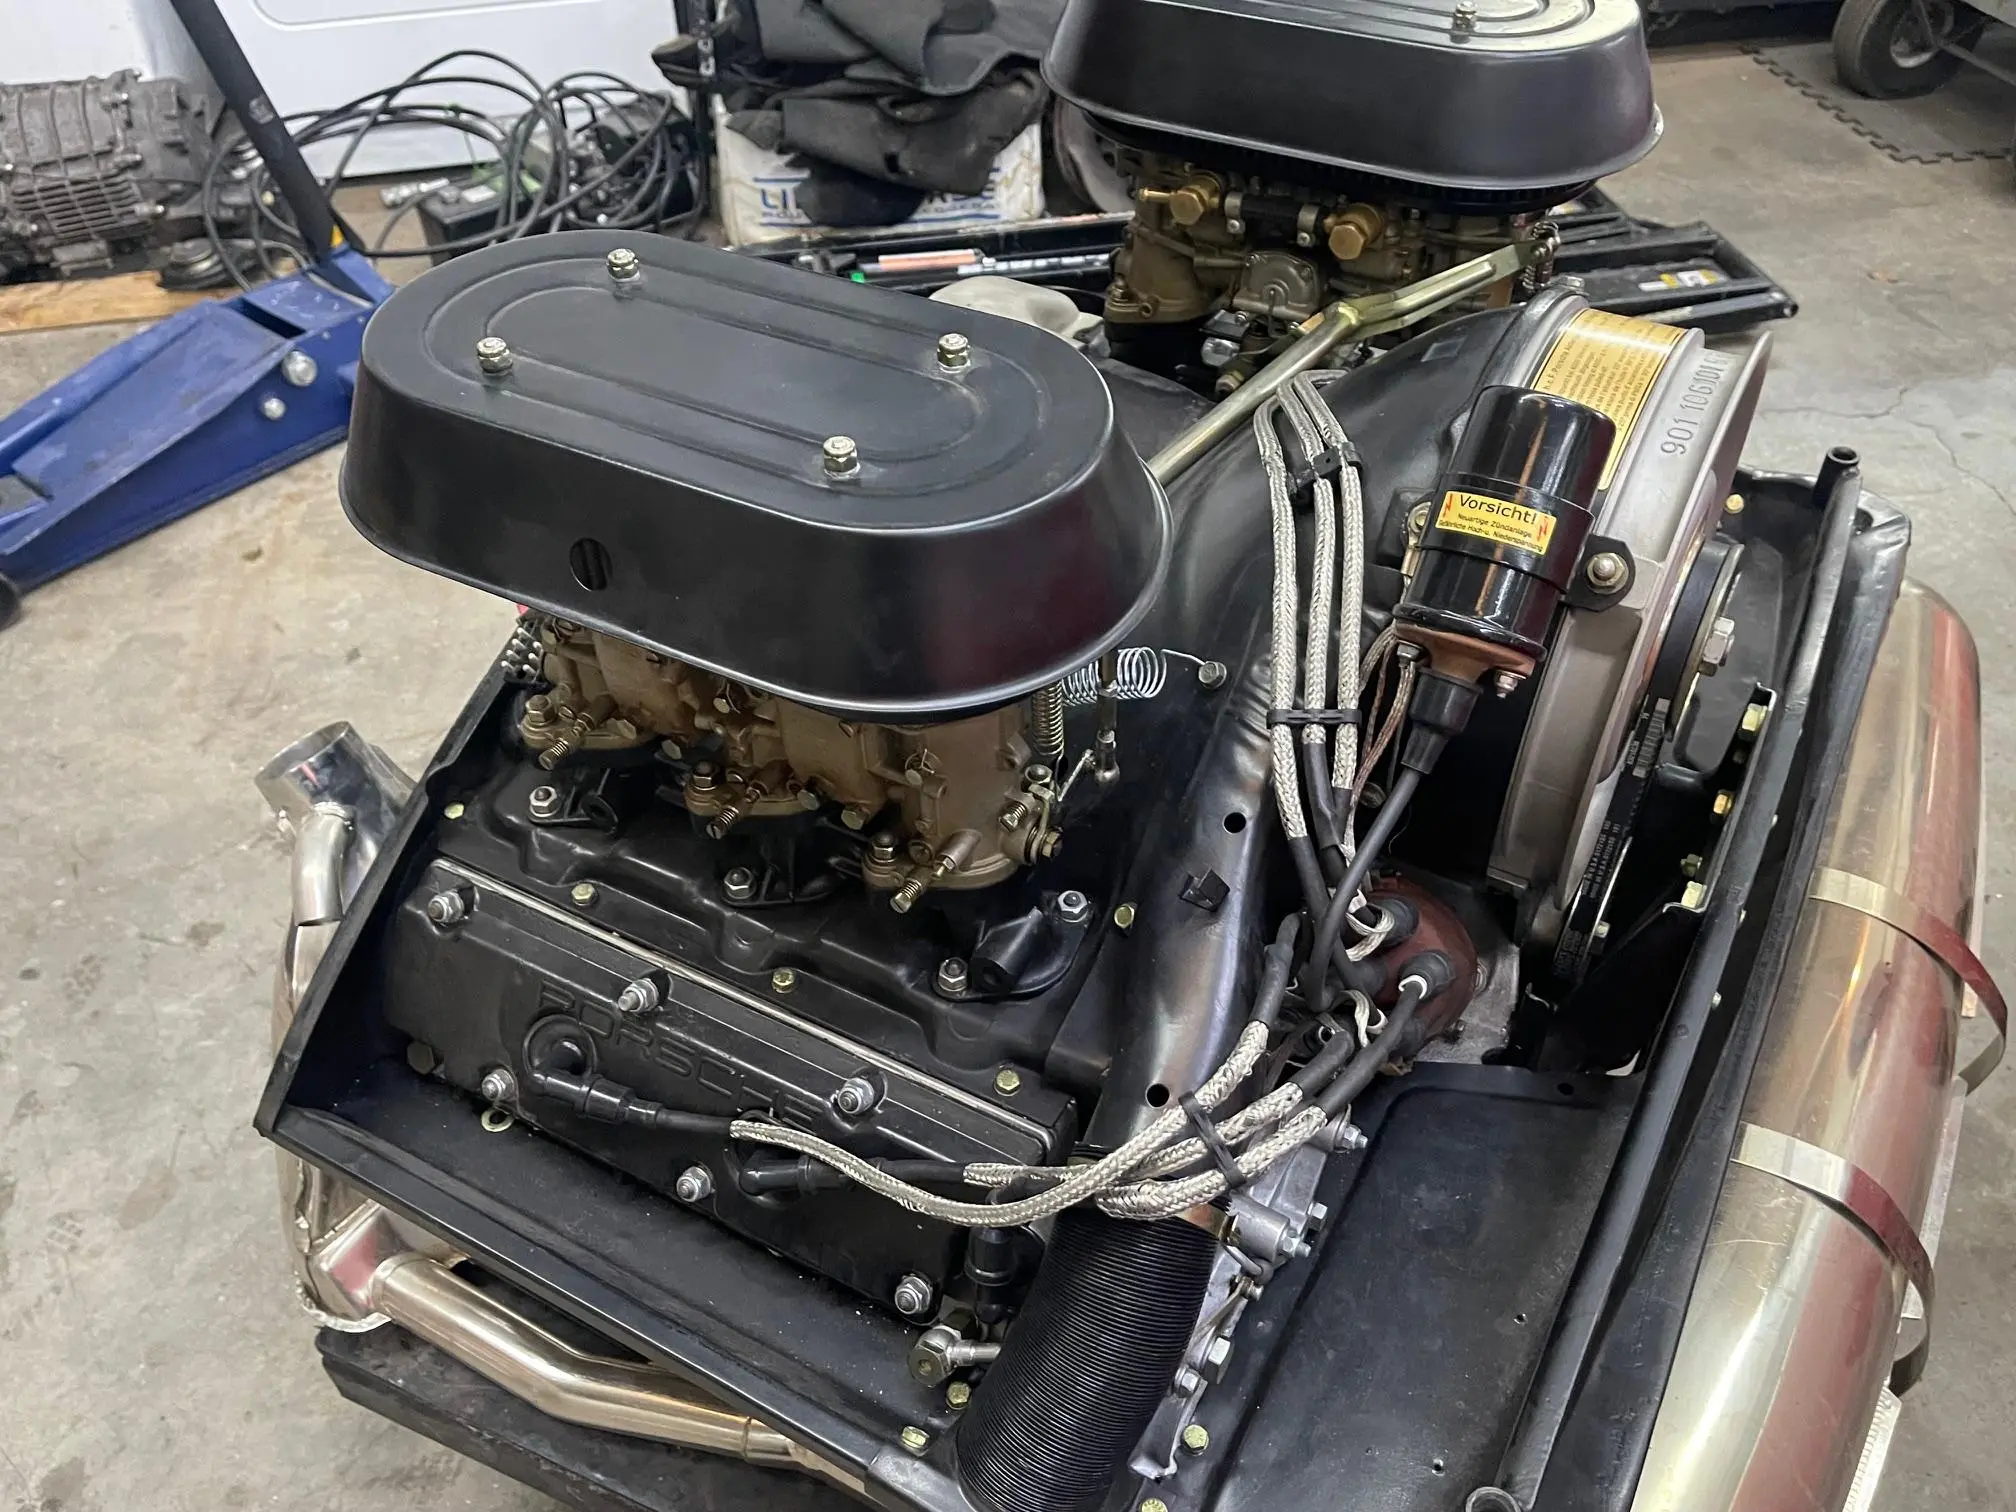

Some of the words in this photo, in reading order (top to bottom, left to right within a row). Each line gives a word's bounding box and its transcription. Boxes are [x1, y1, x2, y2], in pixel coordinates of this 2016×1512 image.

[1661, 418, 1698, 454] 901
[1460, 494, 1537, 525] Vorsicht!
[1491, 518, 1532, 538] Zündanlage
[539, 980, 824, 1135] PORSCHE
